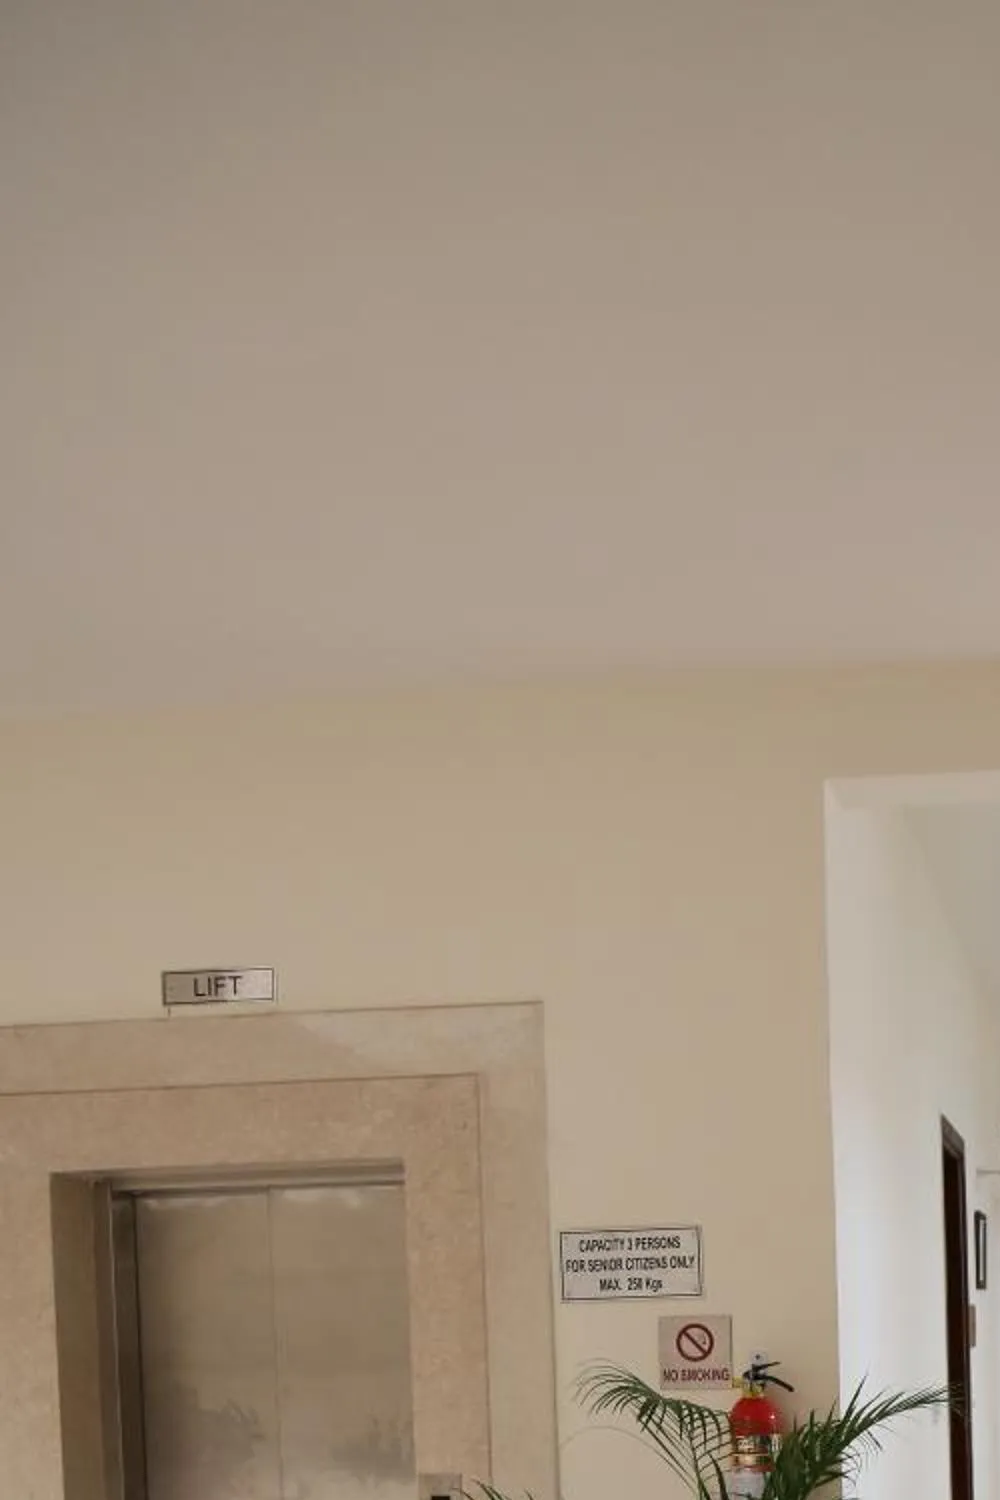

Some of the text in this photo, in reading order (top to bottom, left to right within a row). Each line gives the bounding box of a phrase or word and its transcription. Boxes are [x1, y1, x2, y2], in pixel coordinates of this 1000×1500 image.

[193, 975, 242, 997] LIFT
[579, 1238, 625, 1253] CAPACITY
[635, 1235, 681, 1250] PERSONS
[565, 1255, 695, 1272] FOR SENIOR CITIZENS ONLY
[645, 1278, 662, 1292] Kgs
[663, 1367, 730, 1382] NO SMOKING
